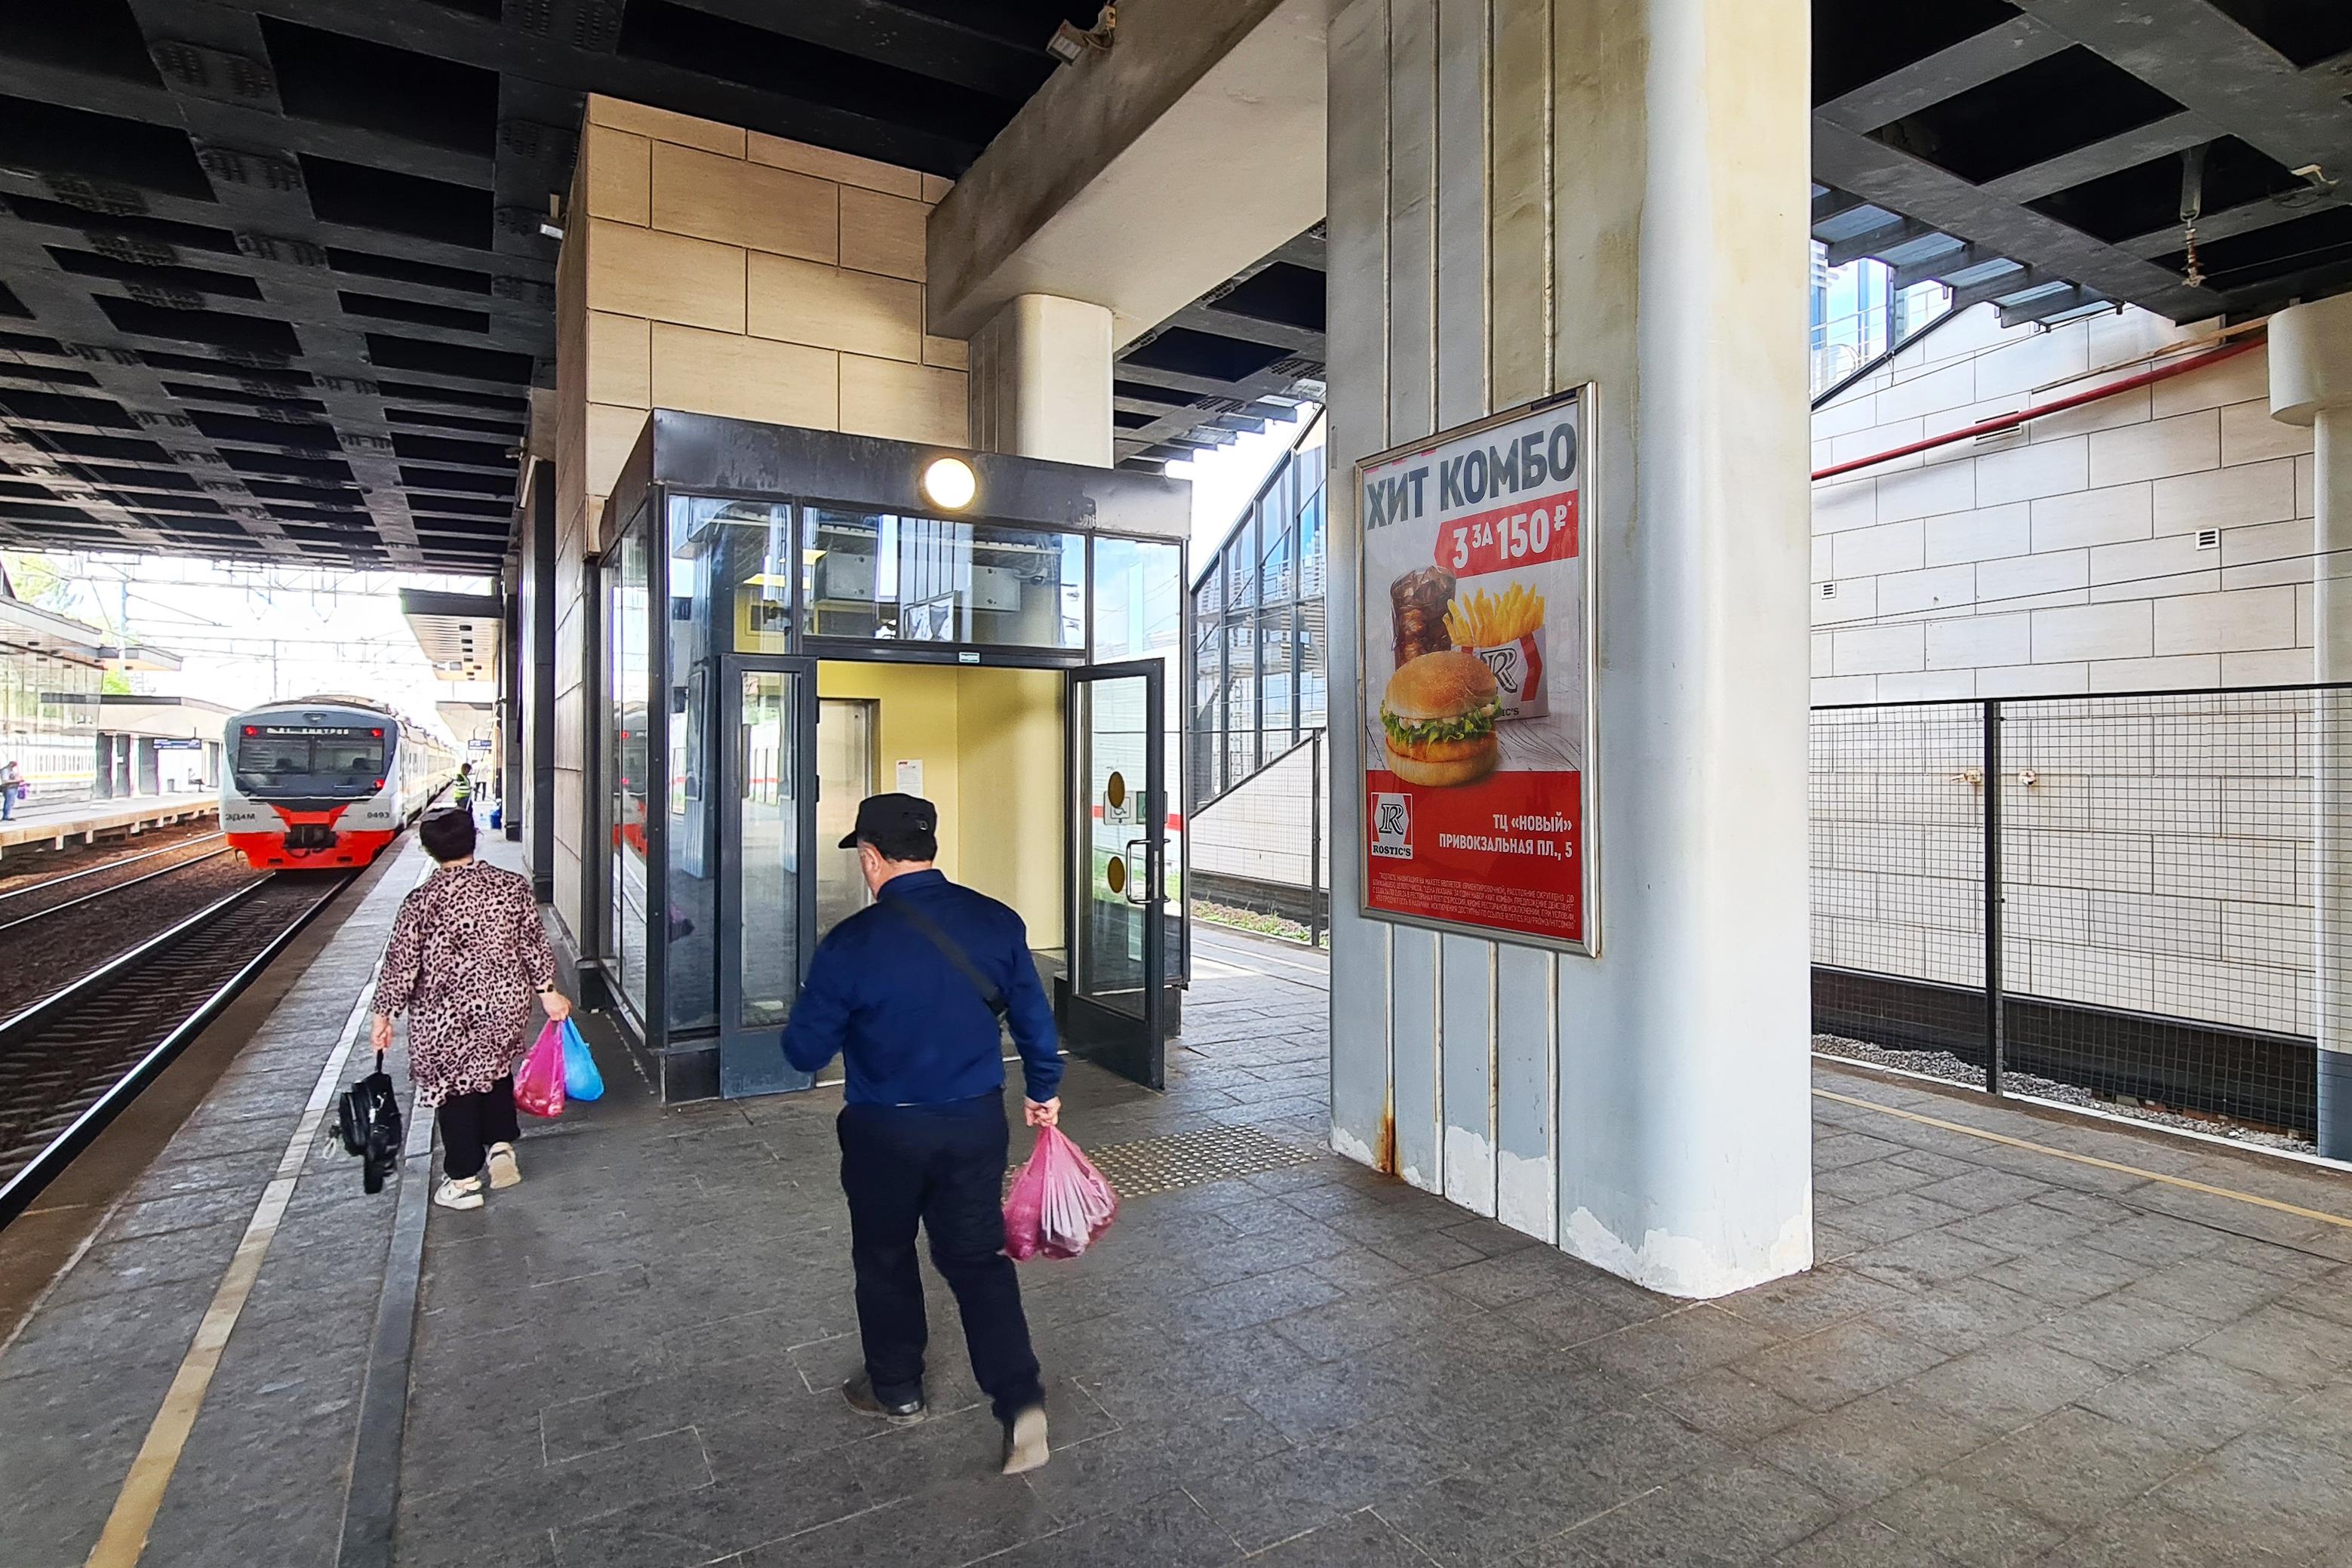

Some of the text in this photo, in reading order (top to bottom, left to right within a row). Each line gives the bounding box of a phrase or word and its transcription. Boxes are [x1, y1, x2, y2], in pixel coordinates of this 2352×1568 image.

[1367, 423, 1577, 530] ХИТ КОМБО
[1453, 527, 1469, 569] 3
[1493, 811, 1572, 832] ТЦ «НОВЫЙ»
[1373, 844, 1411, 857] ROSTIC'S
[1439, 833, 1573, 860] ПРИВОКЗАЛЬНАЯ ПЛ., 5
